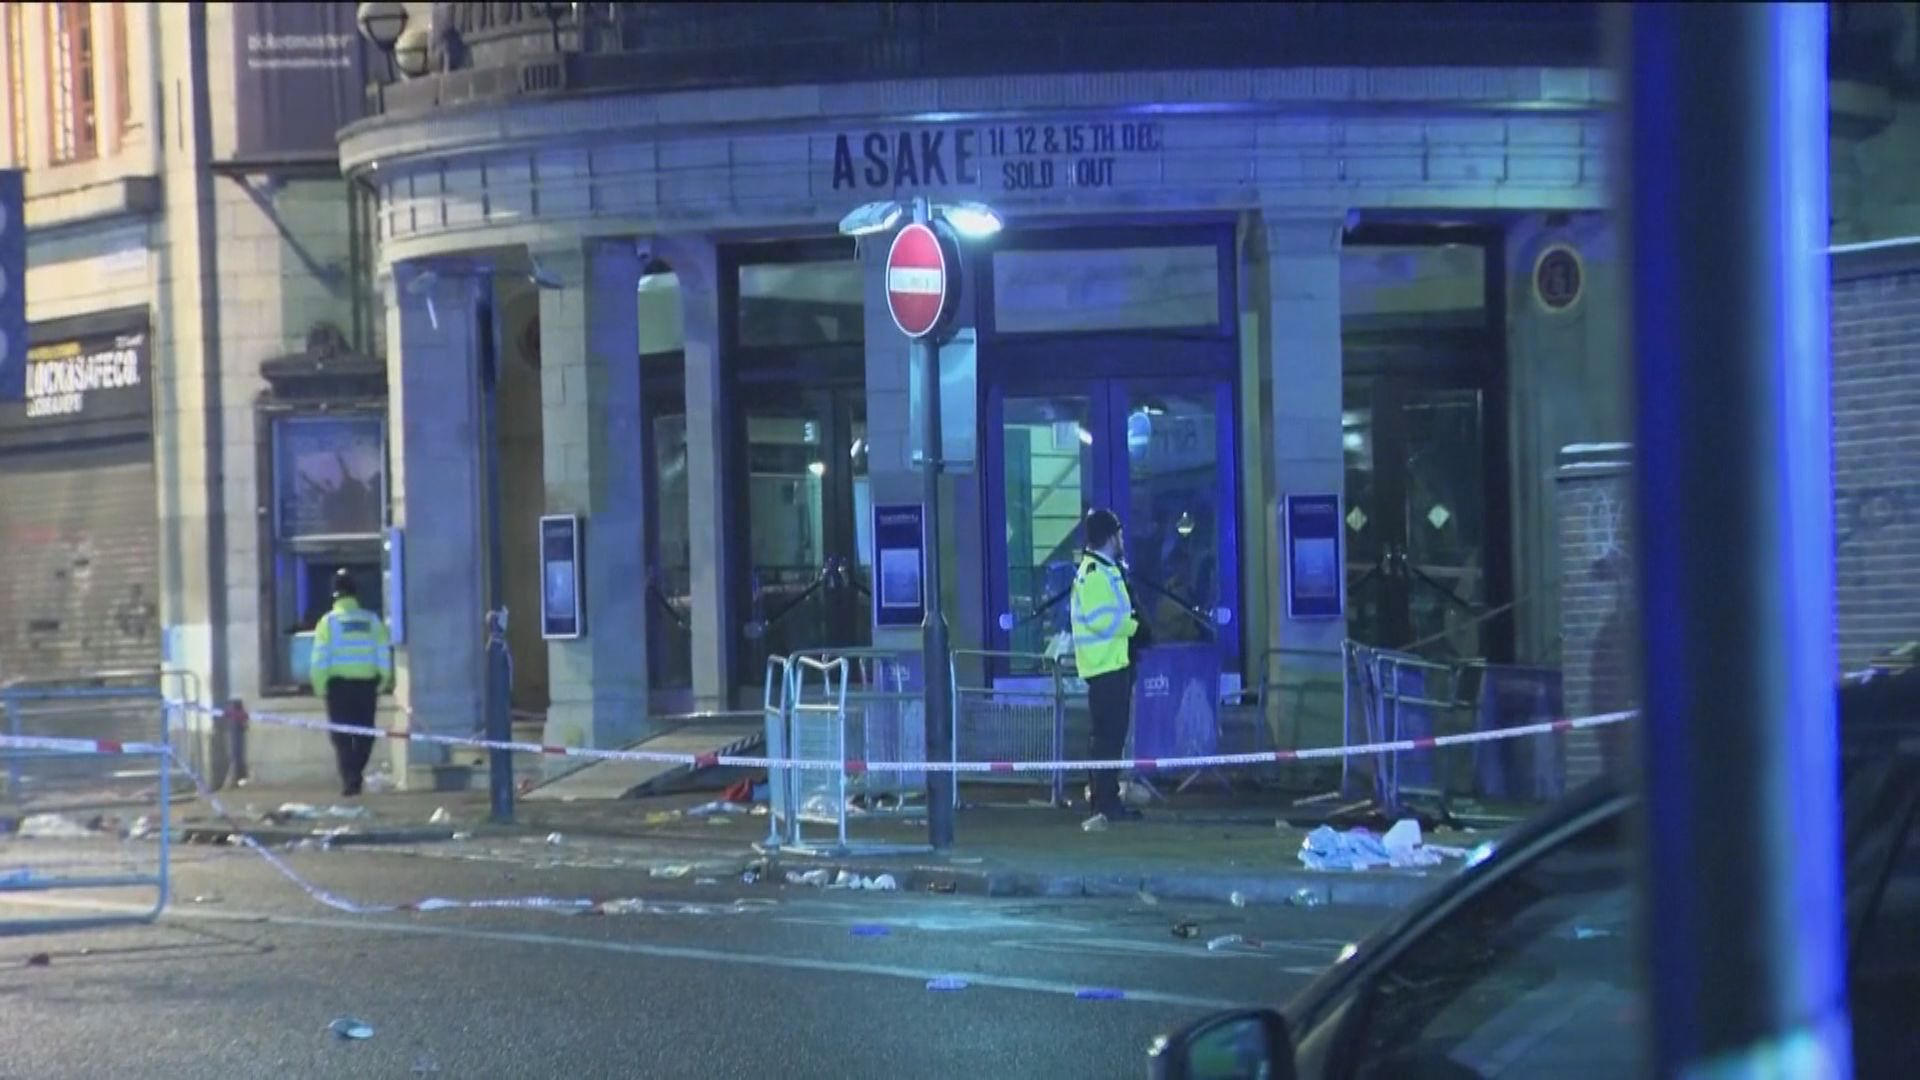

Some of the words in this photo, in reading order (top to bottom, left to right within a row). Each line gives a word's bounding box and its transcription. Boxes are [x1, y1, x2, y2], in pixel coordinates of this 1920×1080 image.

[988, 127, 1004, 157] 11
[1014, 126, 1037, 154] 12
[1043, 126, 1059, 153] &
[1122, 121, 1162, 150] DEC
[833, 128, 977, 190] ASAKE
[1003, 159, 1054, 190] SOLD
[1076, 157, 1115, 188] OUT
